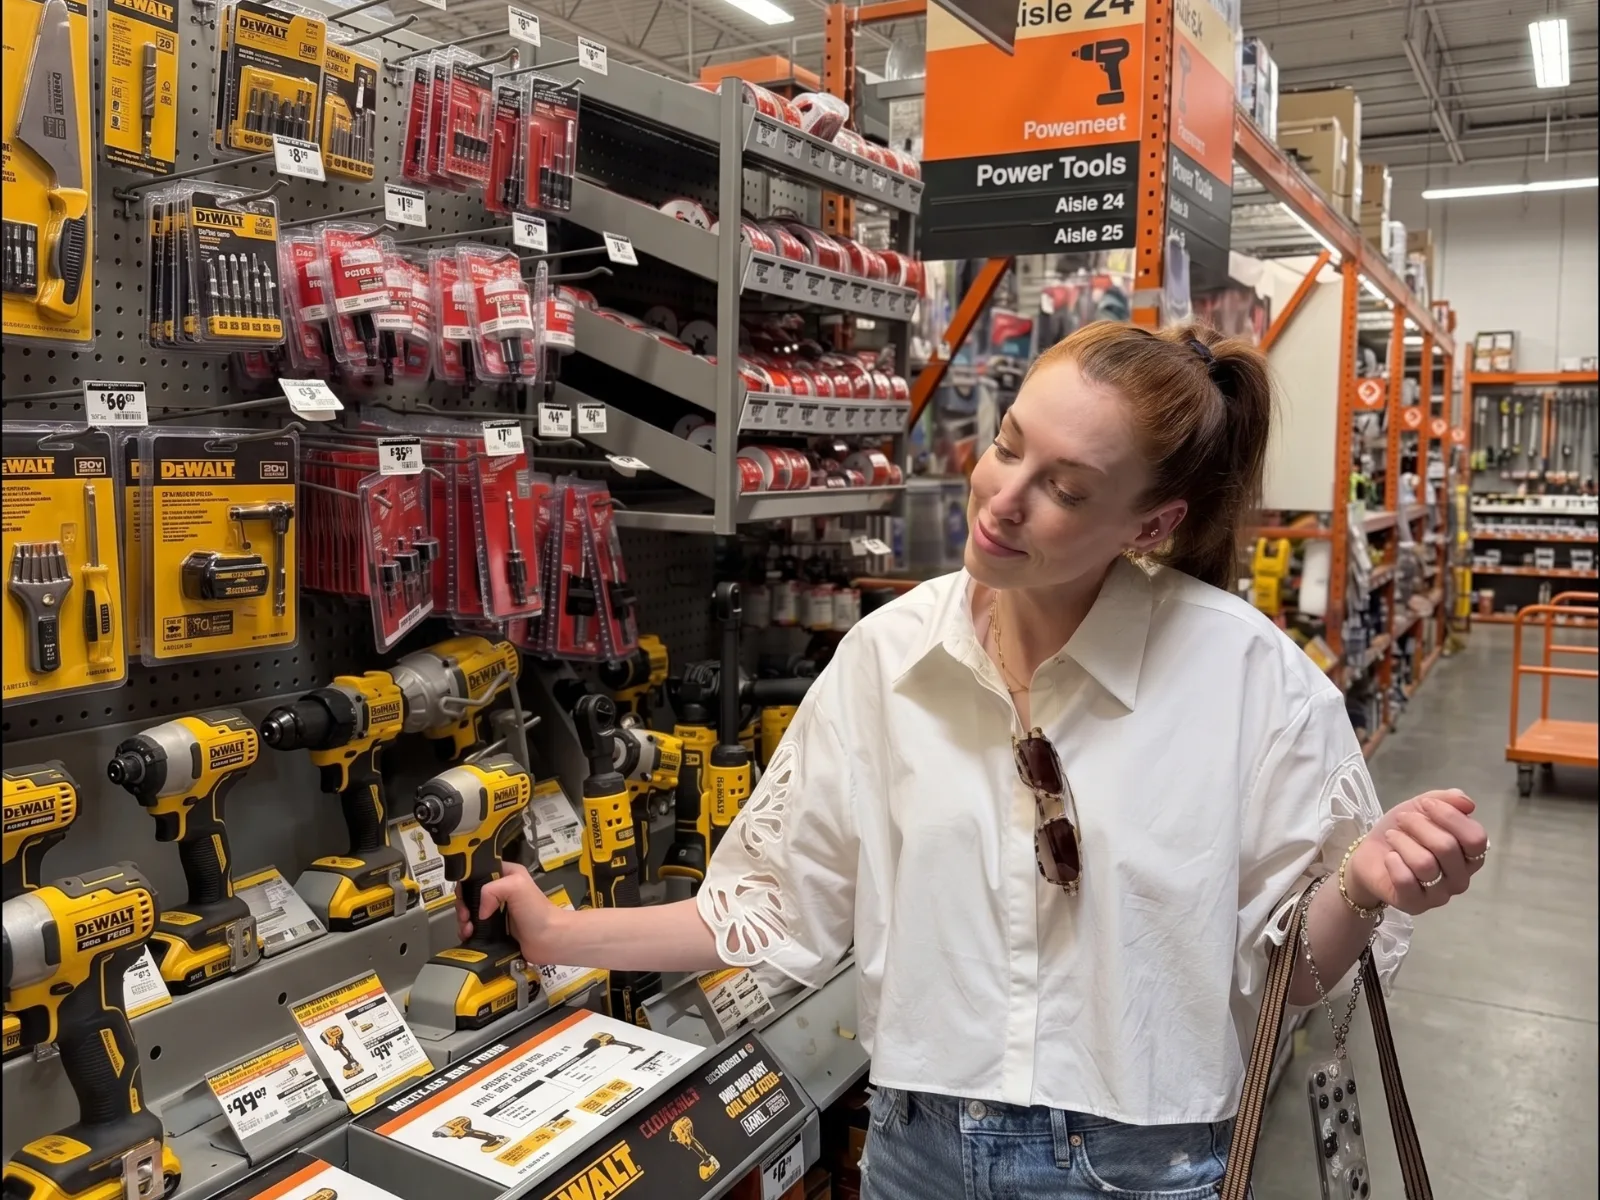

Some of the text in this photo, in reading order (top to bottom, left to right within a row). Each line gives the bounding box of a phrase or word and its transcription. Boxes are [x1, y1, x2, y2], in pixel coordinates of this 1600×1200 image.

[1017, 0, 1073, 28] isle
[1024, 113, 1127, 140] Powemeet
[976, 152, 1128, 188] Power Tools
[1055, 193, 1125, 214] Aisle 24
[1053, 224, 1124, 245] Aisle 25
[161, 461, 235, 477] DEWALT
[4, 797, 57, 820] DEWALT
[75, 907, 135, 938] DEWALT
